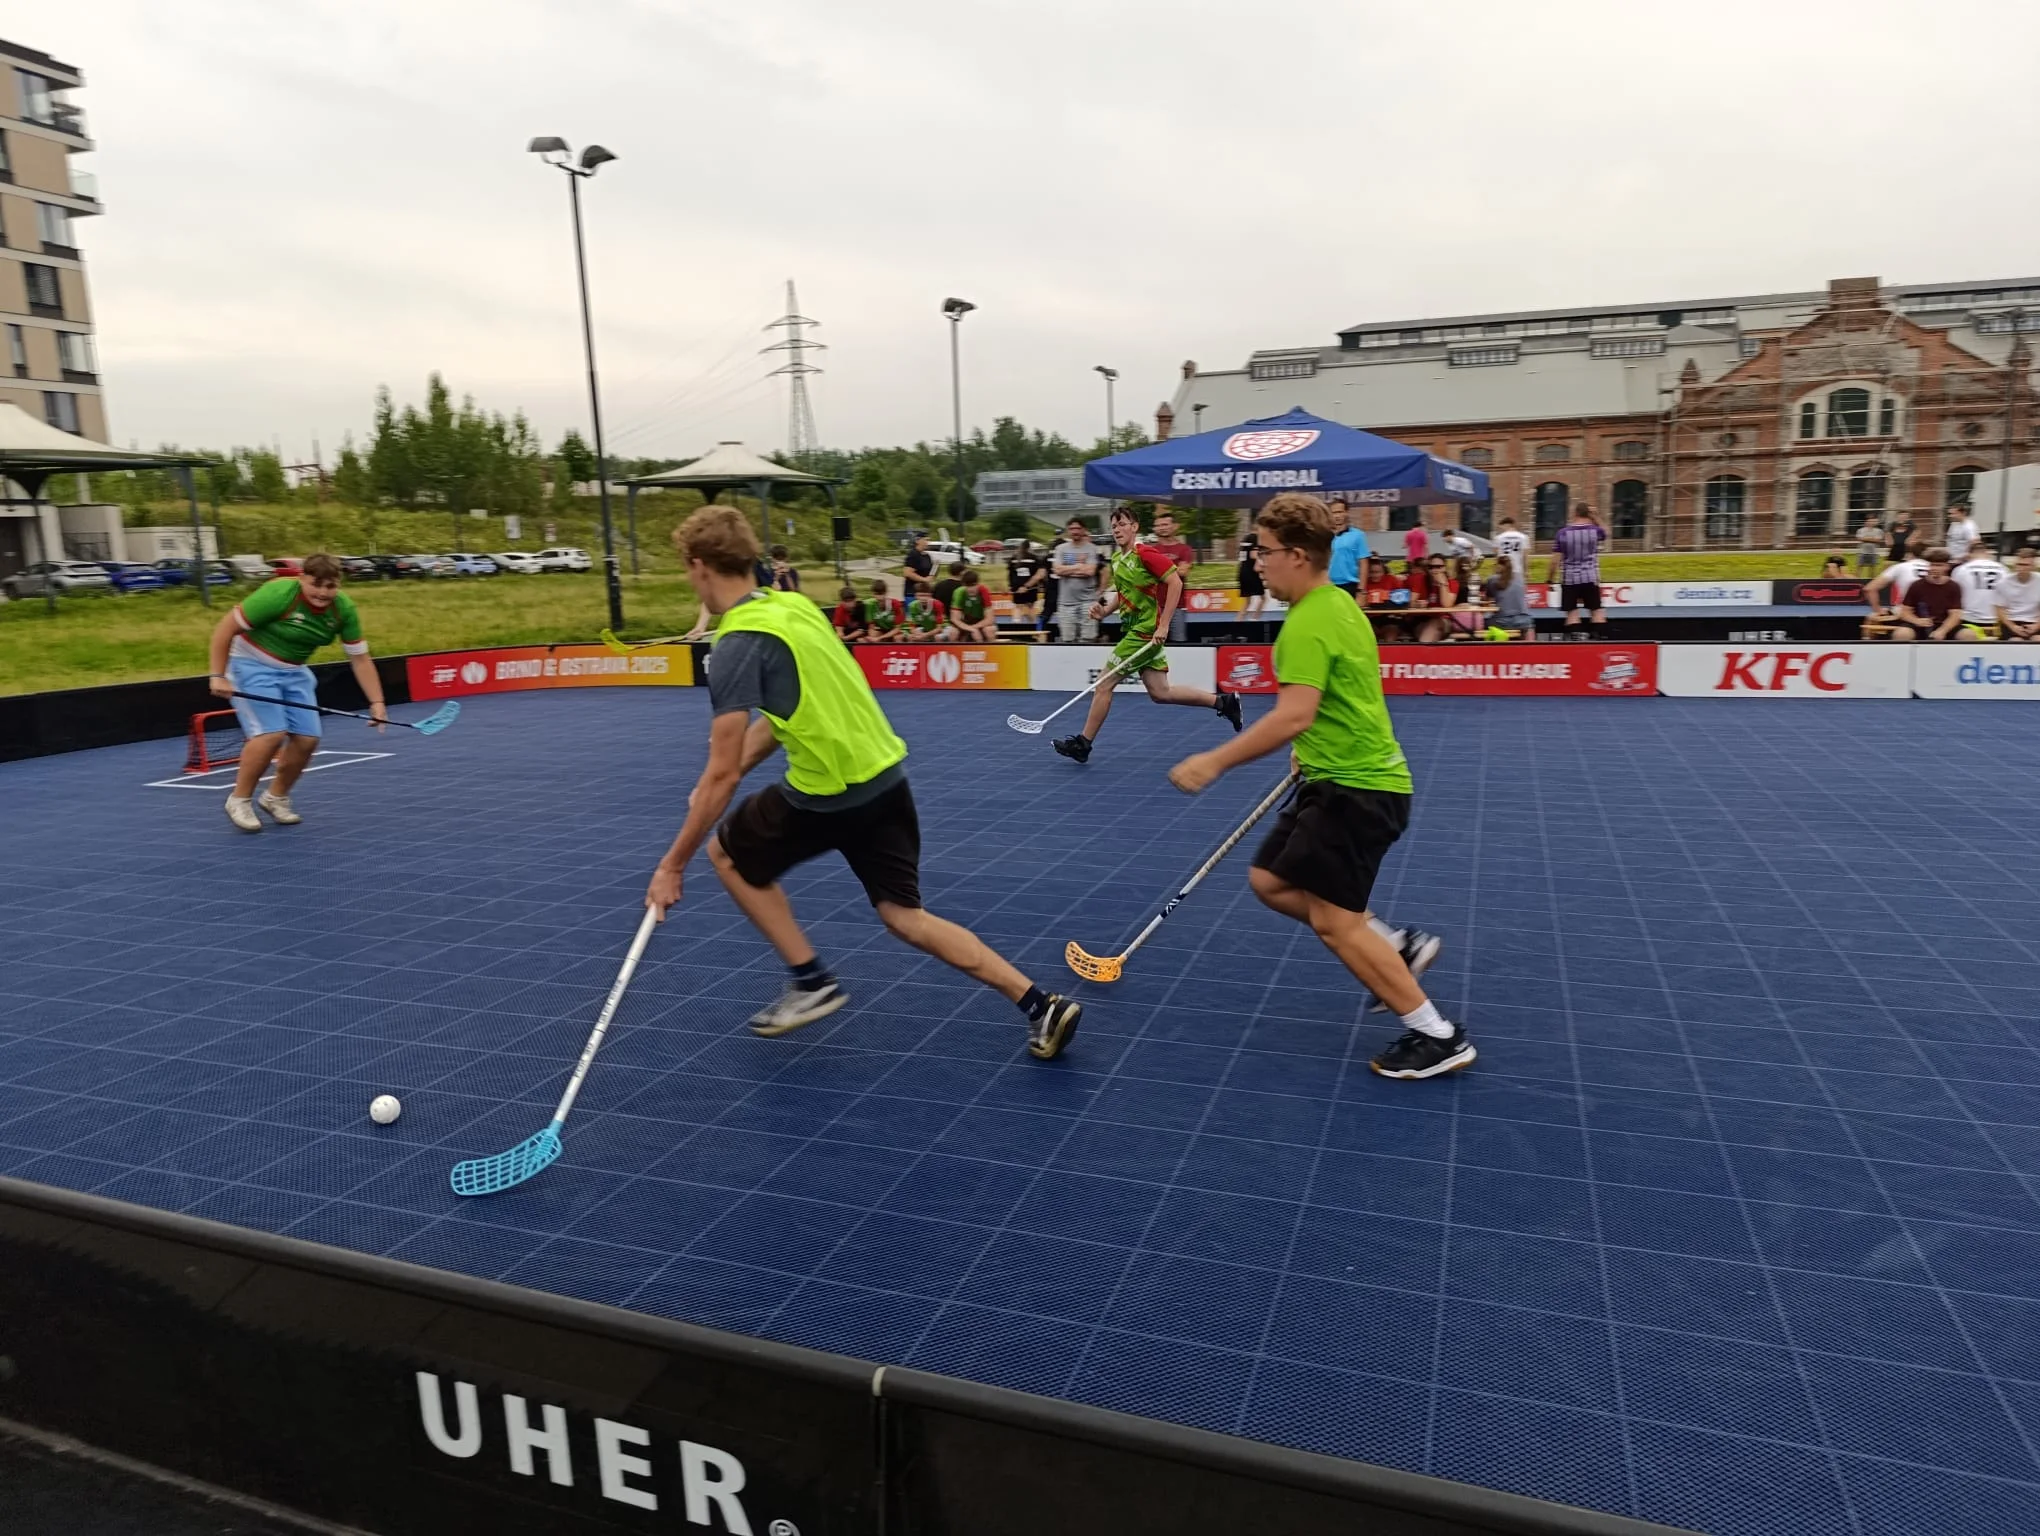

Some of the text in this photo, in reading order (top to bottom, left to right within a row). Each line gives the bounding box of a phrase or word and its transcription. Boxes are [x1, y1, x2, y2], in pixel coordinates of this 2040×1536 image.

[1172, 468, 1323, 489] ČESKÝ FLORBAL
[1600, 586, 1632, 604] FC
[1393, 663, 1498, 680] FLOORBALL
[1499, 663, 1572, 680] LEAGUE
[1714, 651, 1854, 691] KFC
[416, 1371, 753, 1536] UHER
